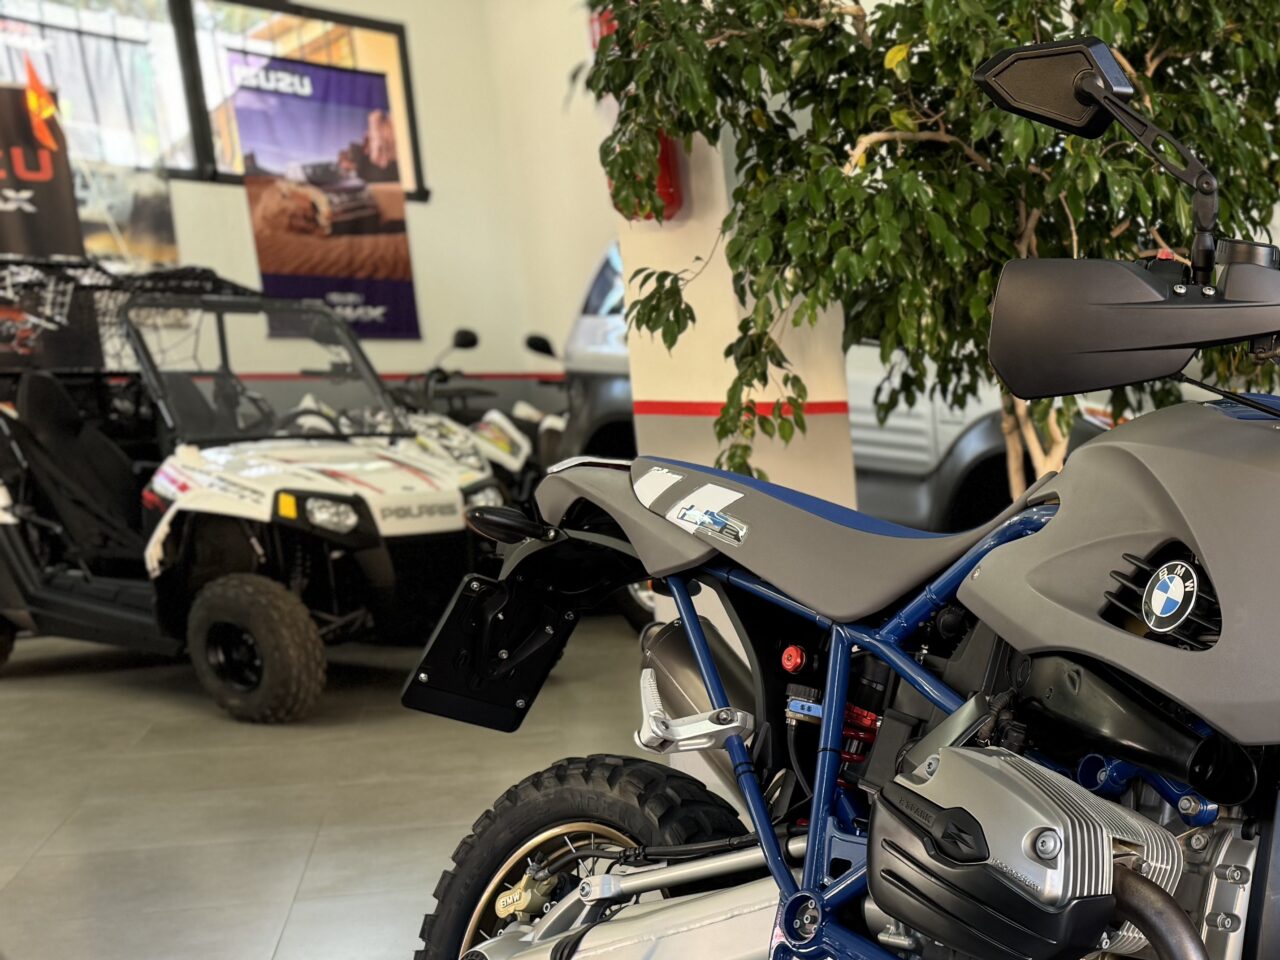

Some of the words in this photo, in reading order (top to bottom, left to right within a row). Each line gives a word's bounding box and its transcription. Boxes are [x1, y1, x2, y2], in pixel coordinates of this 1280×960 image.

[381, 503, 458, 520] POLARIS
[1159, 565, 1194, 592] BMW
[501, 889, 522, 908] BMW
